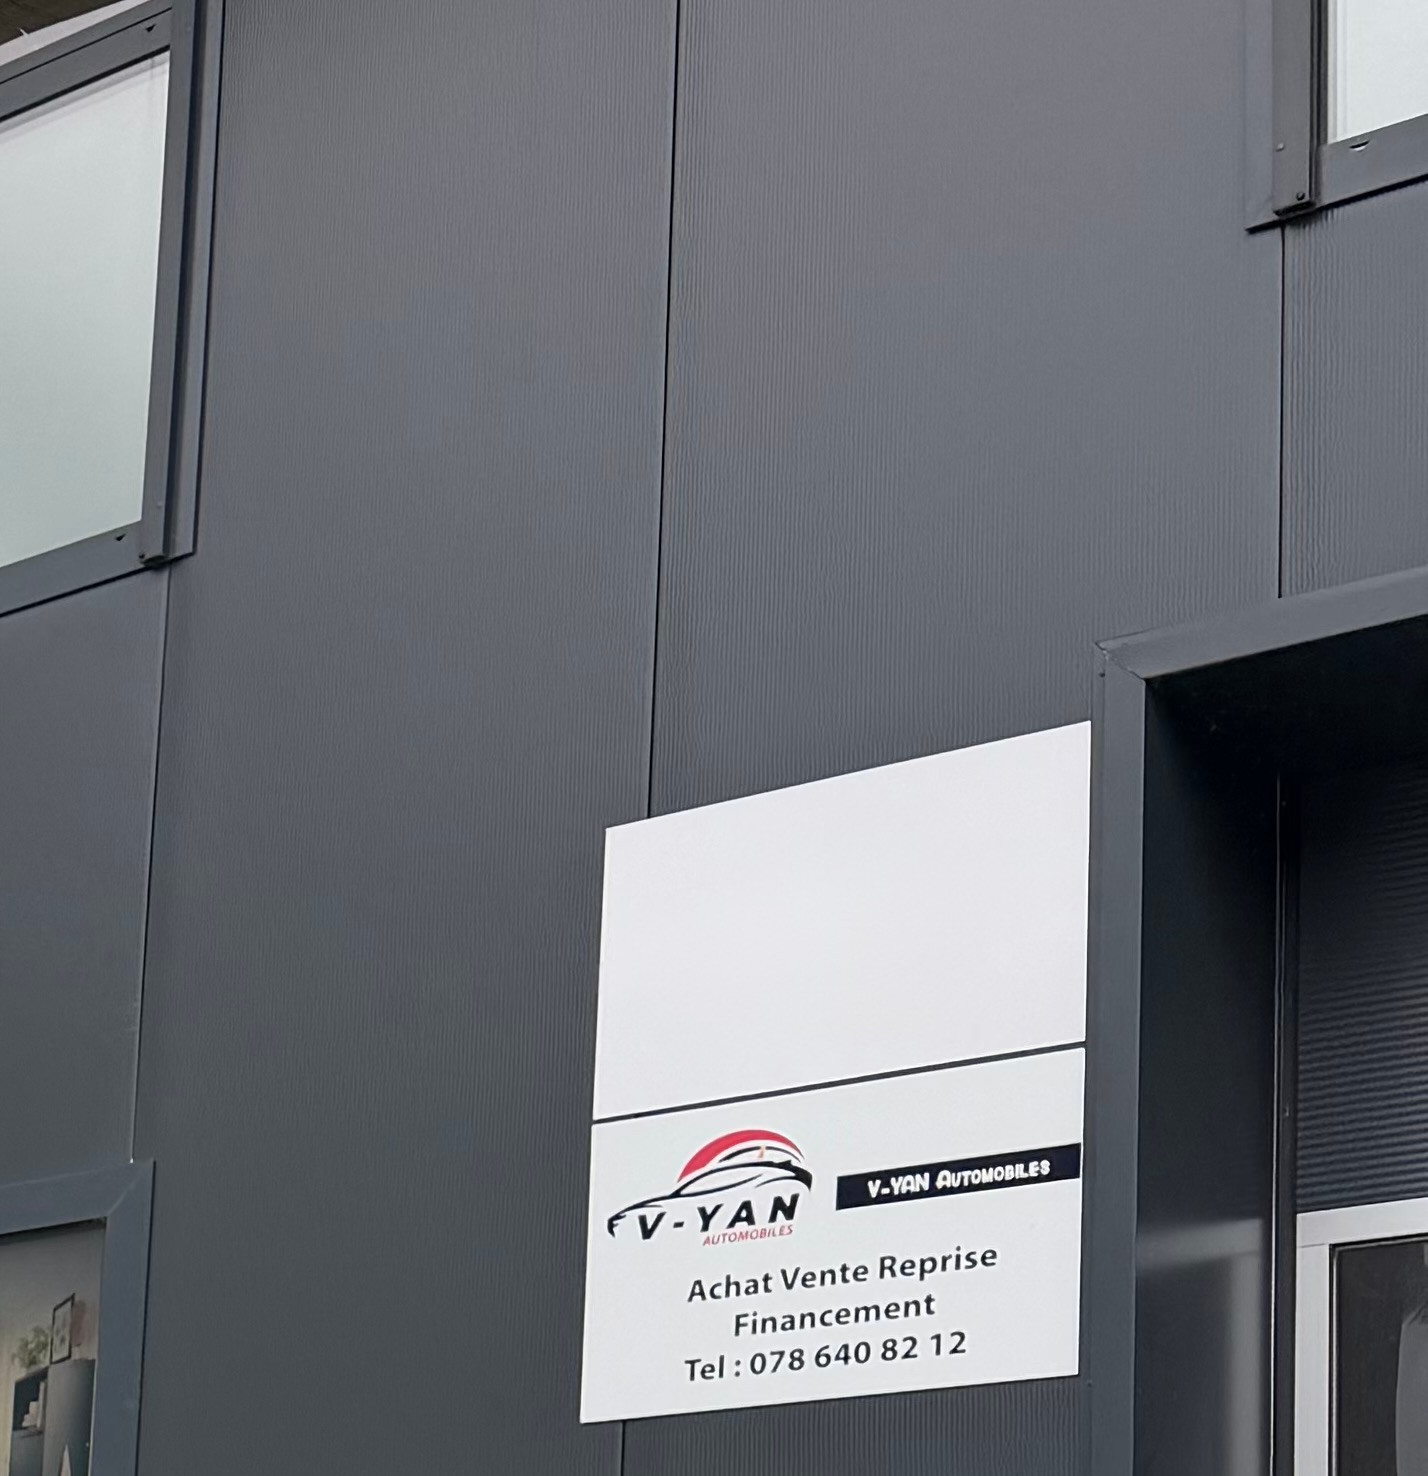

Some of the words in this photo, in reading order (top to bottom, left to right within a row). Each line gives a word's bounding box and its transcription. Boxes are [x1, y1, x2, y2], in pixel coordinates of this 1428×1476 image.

[867, 1172, 930, 1198] V-YAN
[638, 1193, 800, 1240] V-YAN
[702, 1224, 794, 1246] AUTOMOBILES
[687, 1272, 773, 1302] Achat
[780, 1262, 869, 1291] Vente
[879, 1245, 998, 1281] Reprise
[734, 1294, 937, 1337] Financement
[749, 1348, 806, 1376] 078
[814, 1341, 872, 1368] 640
[880, 1335, 919, 1362] 82
[930, 1330, 967, 1356] 12
